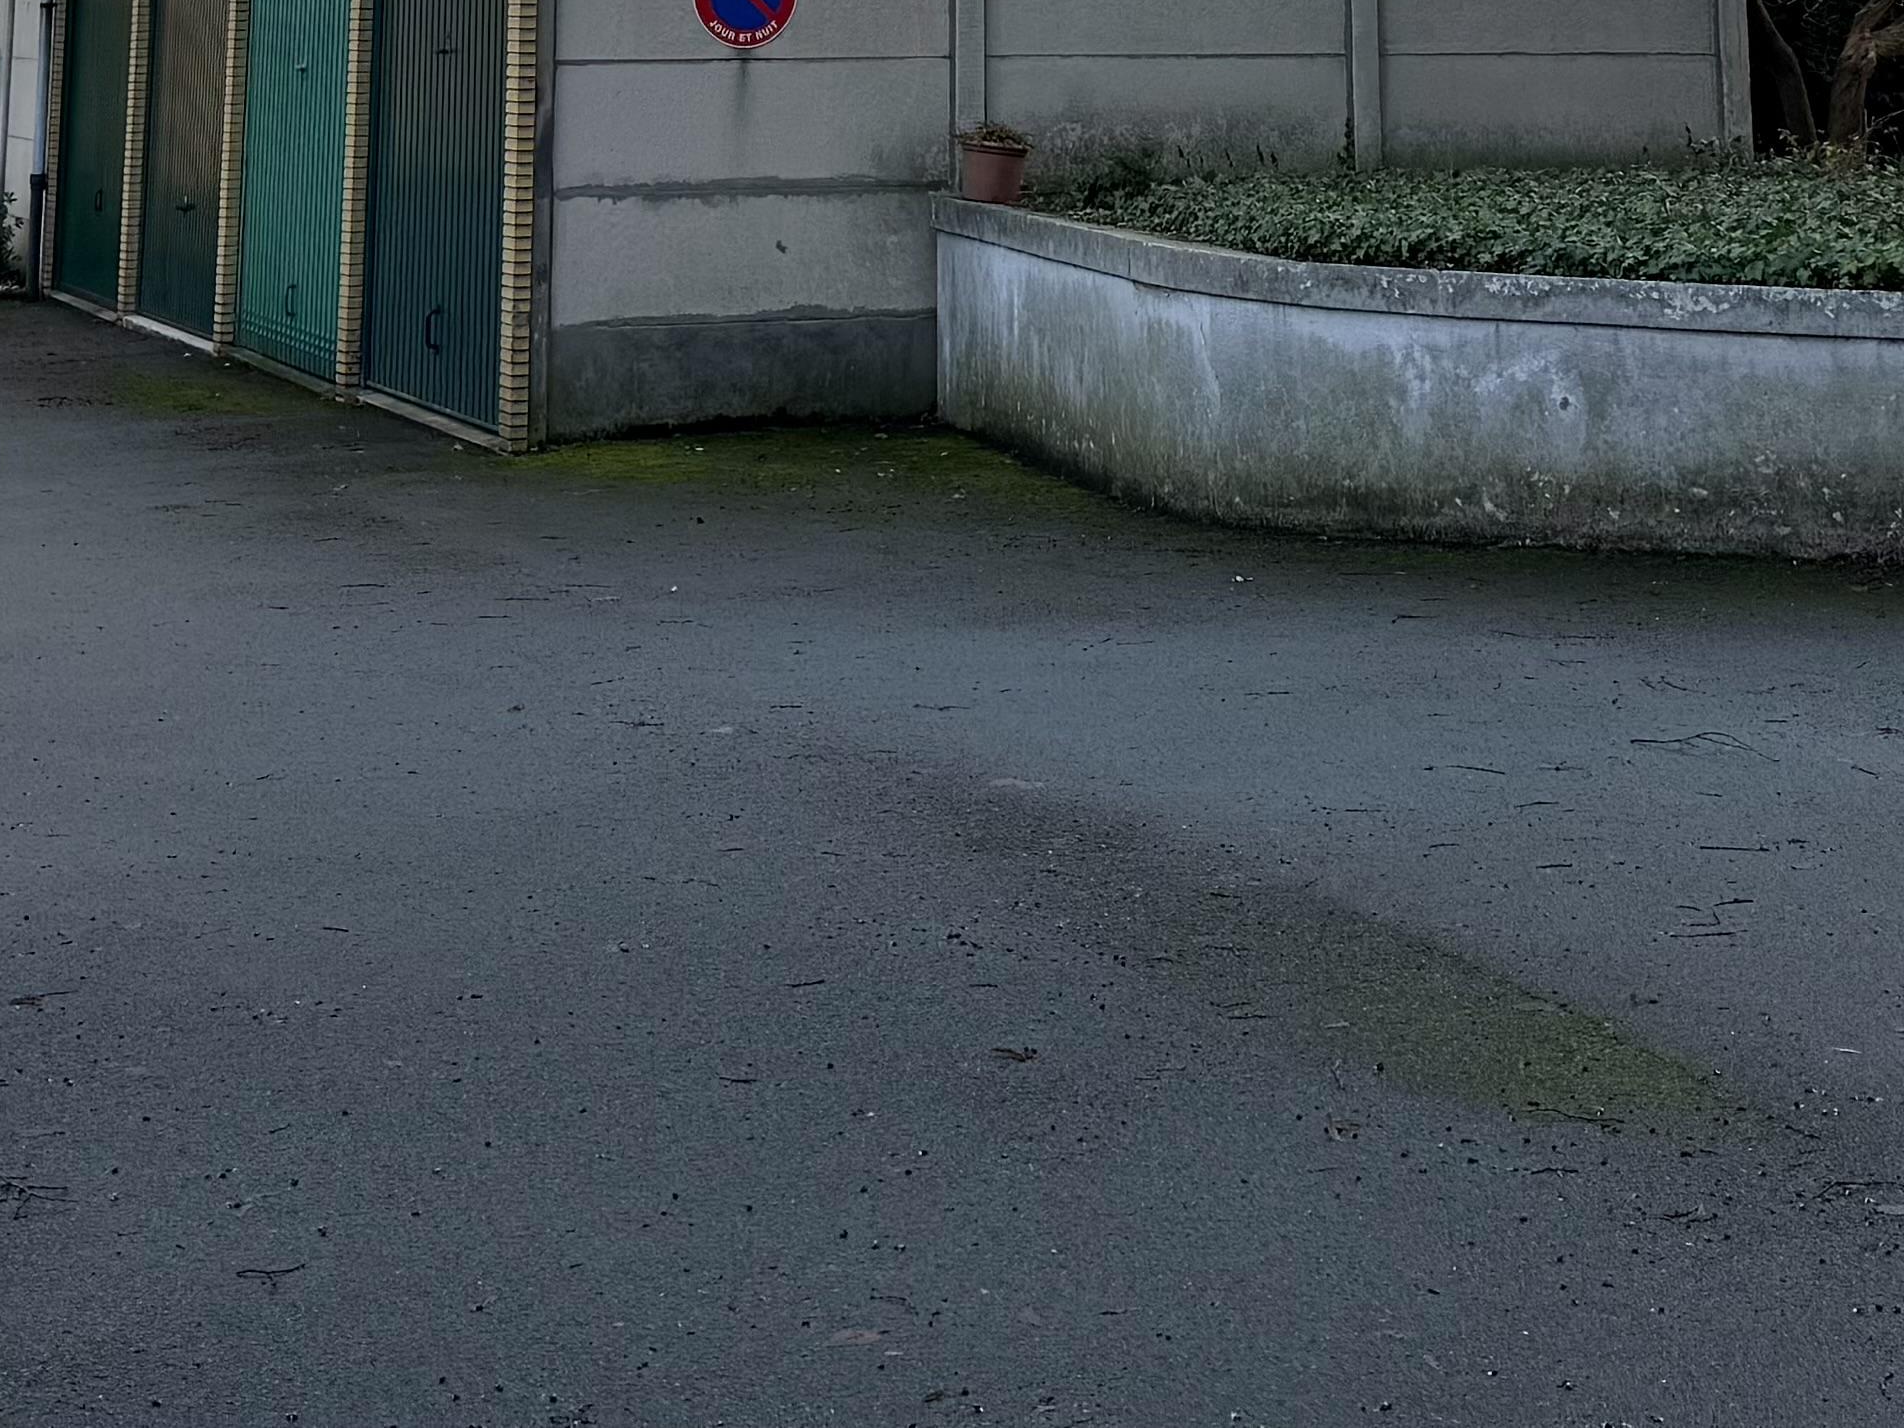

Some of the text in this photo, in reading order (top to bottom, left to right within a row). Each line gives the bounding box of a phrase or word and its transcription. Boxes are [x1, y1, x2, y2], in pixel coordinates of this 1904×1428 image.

[709, 20, 777, 42] JOUR ET NUIT
